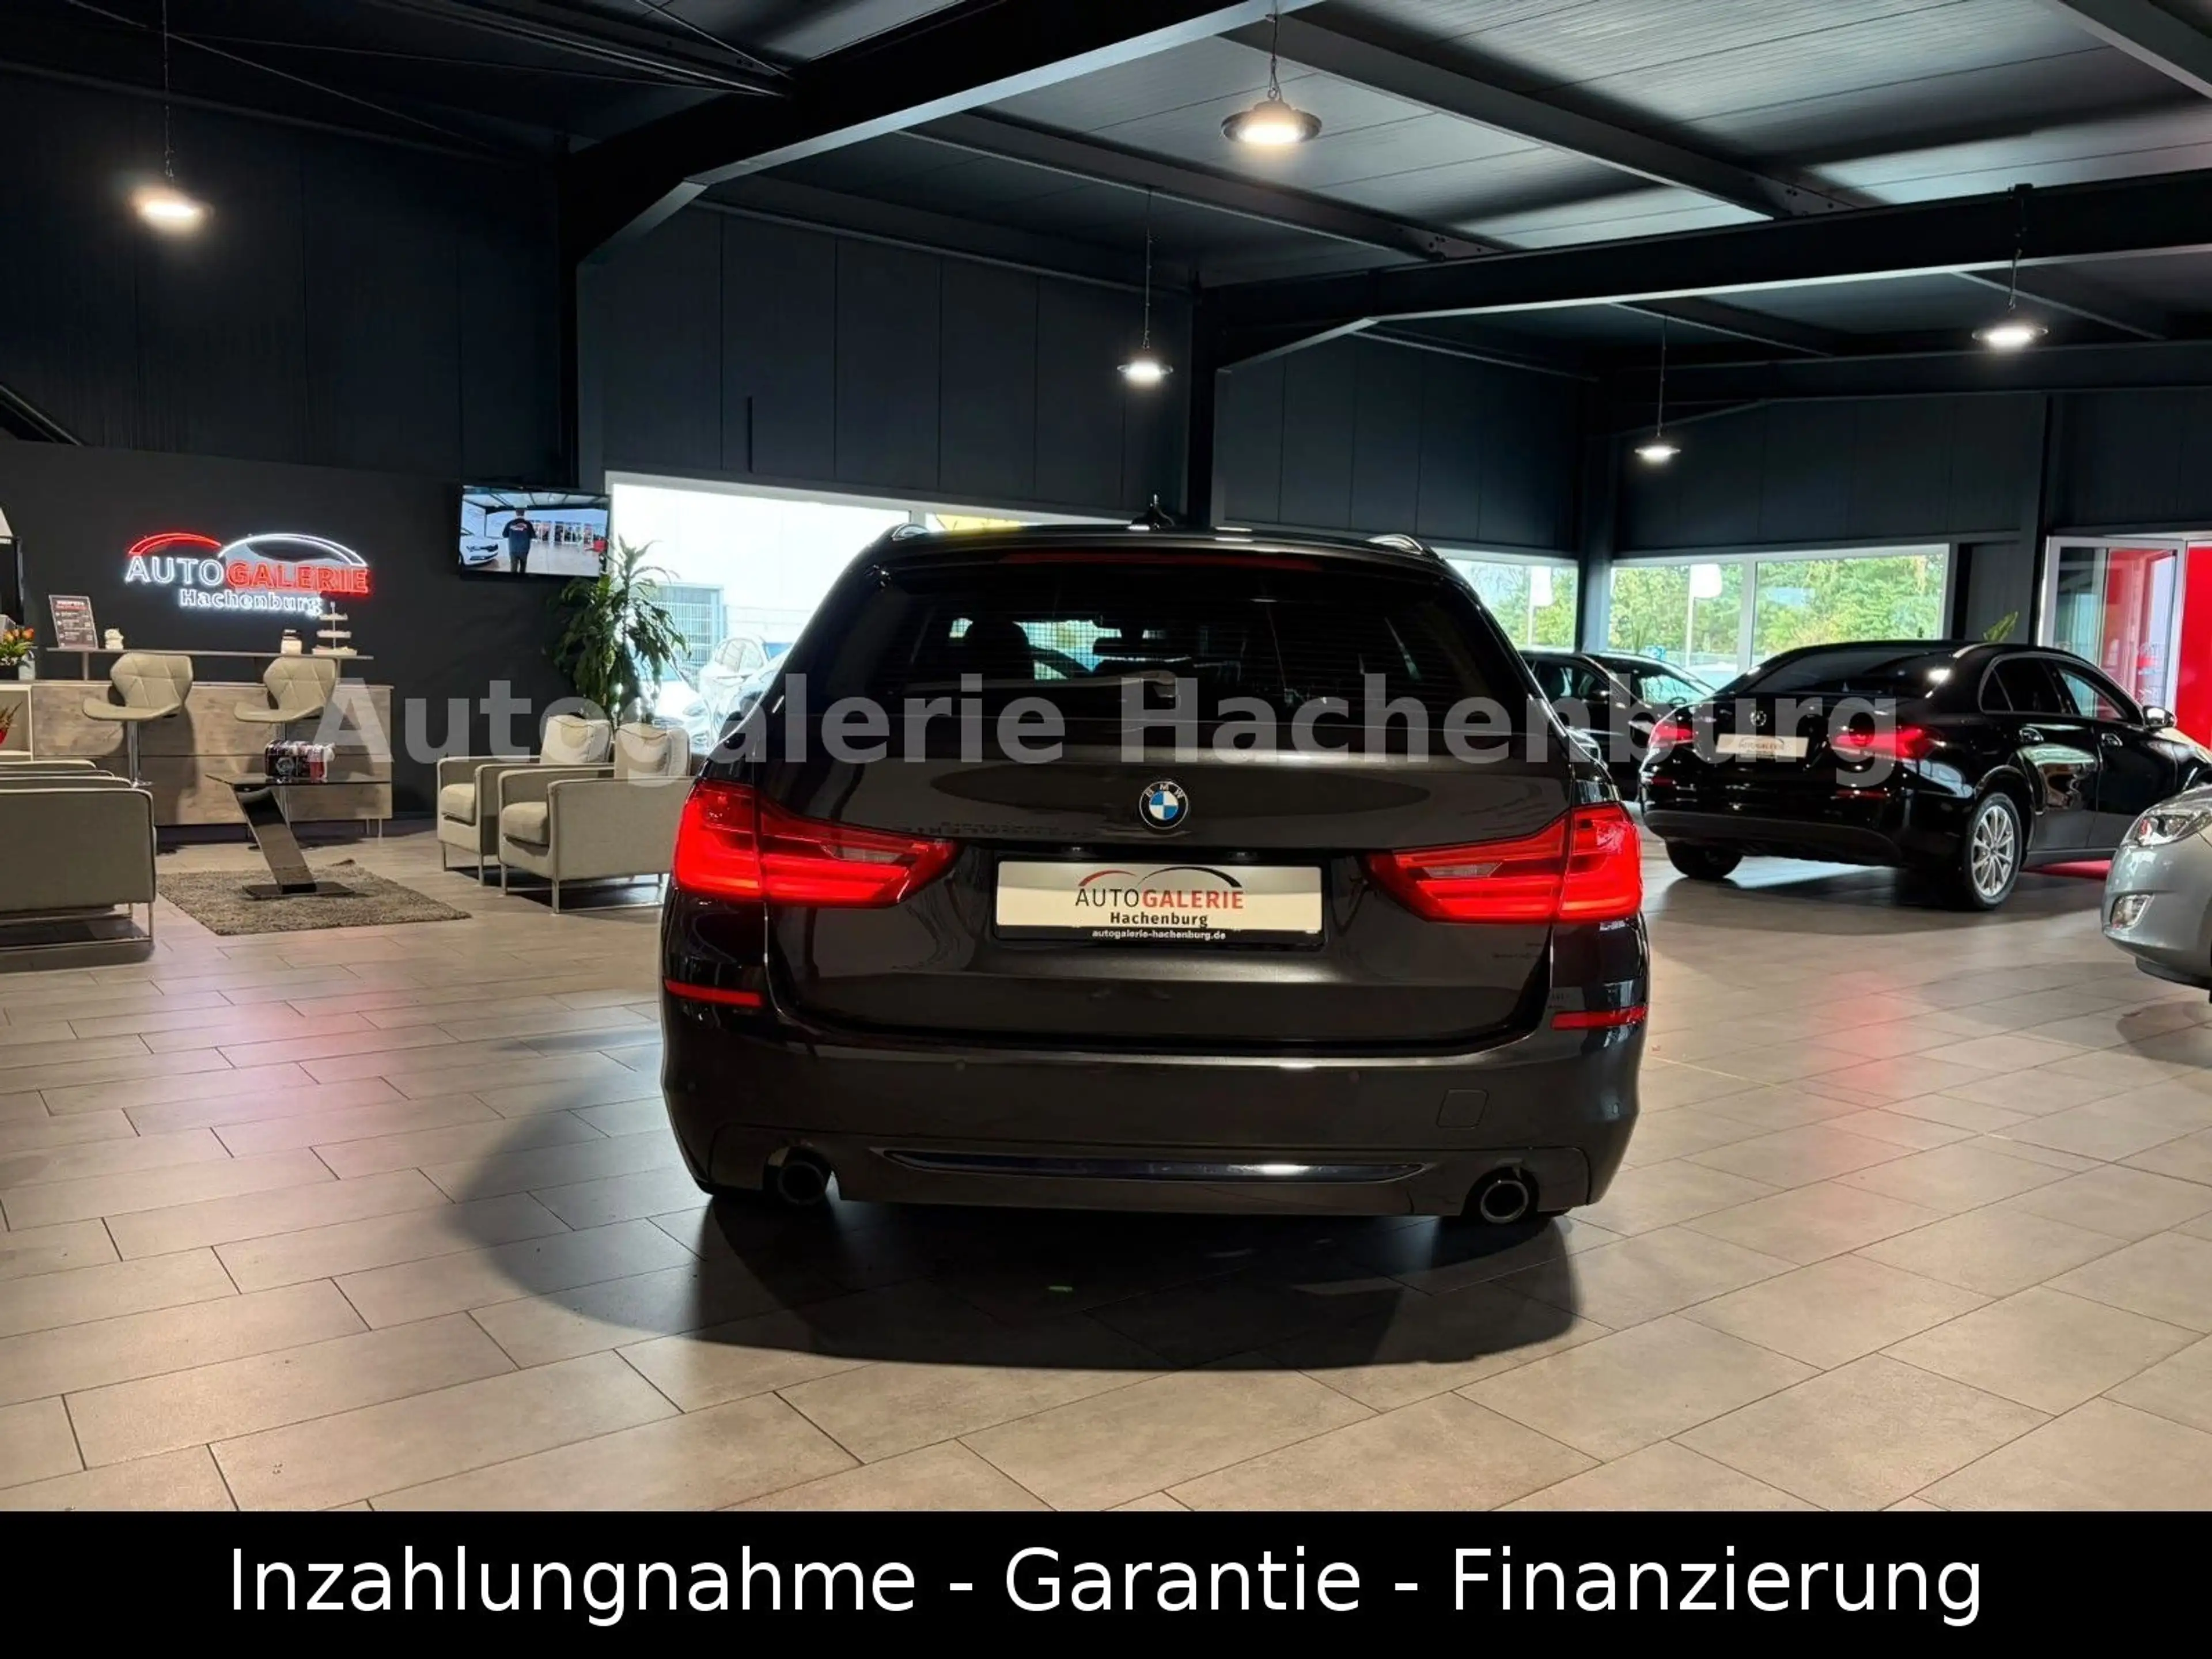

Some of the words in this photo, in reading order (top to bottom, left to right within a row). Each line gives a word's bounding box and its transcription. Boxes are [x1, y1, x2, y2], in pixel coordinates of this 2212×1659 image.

[125, 556, 369, 593] AUTOGALERIE
[179, 589, 323, 618] Hachenburg
[1075, 888, 1244, 909] AUTOGALERIE
[1110, 912, 1208, 928] Hachenburg
[1092, 929, 1226, 940] autogalerie-hachenburg.de
